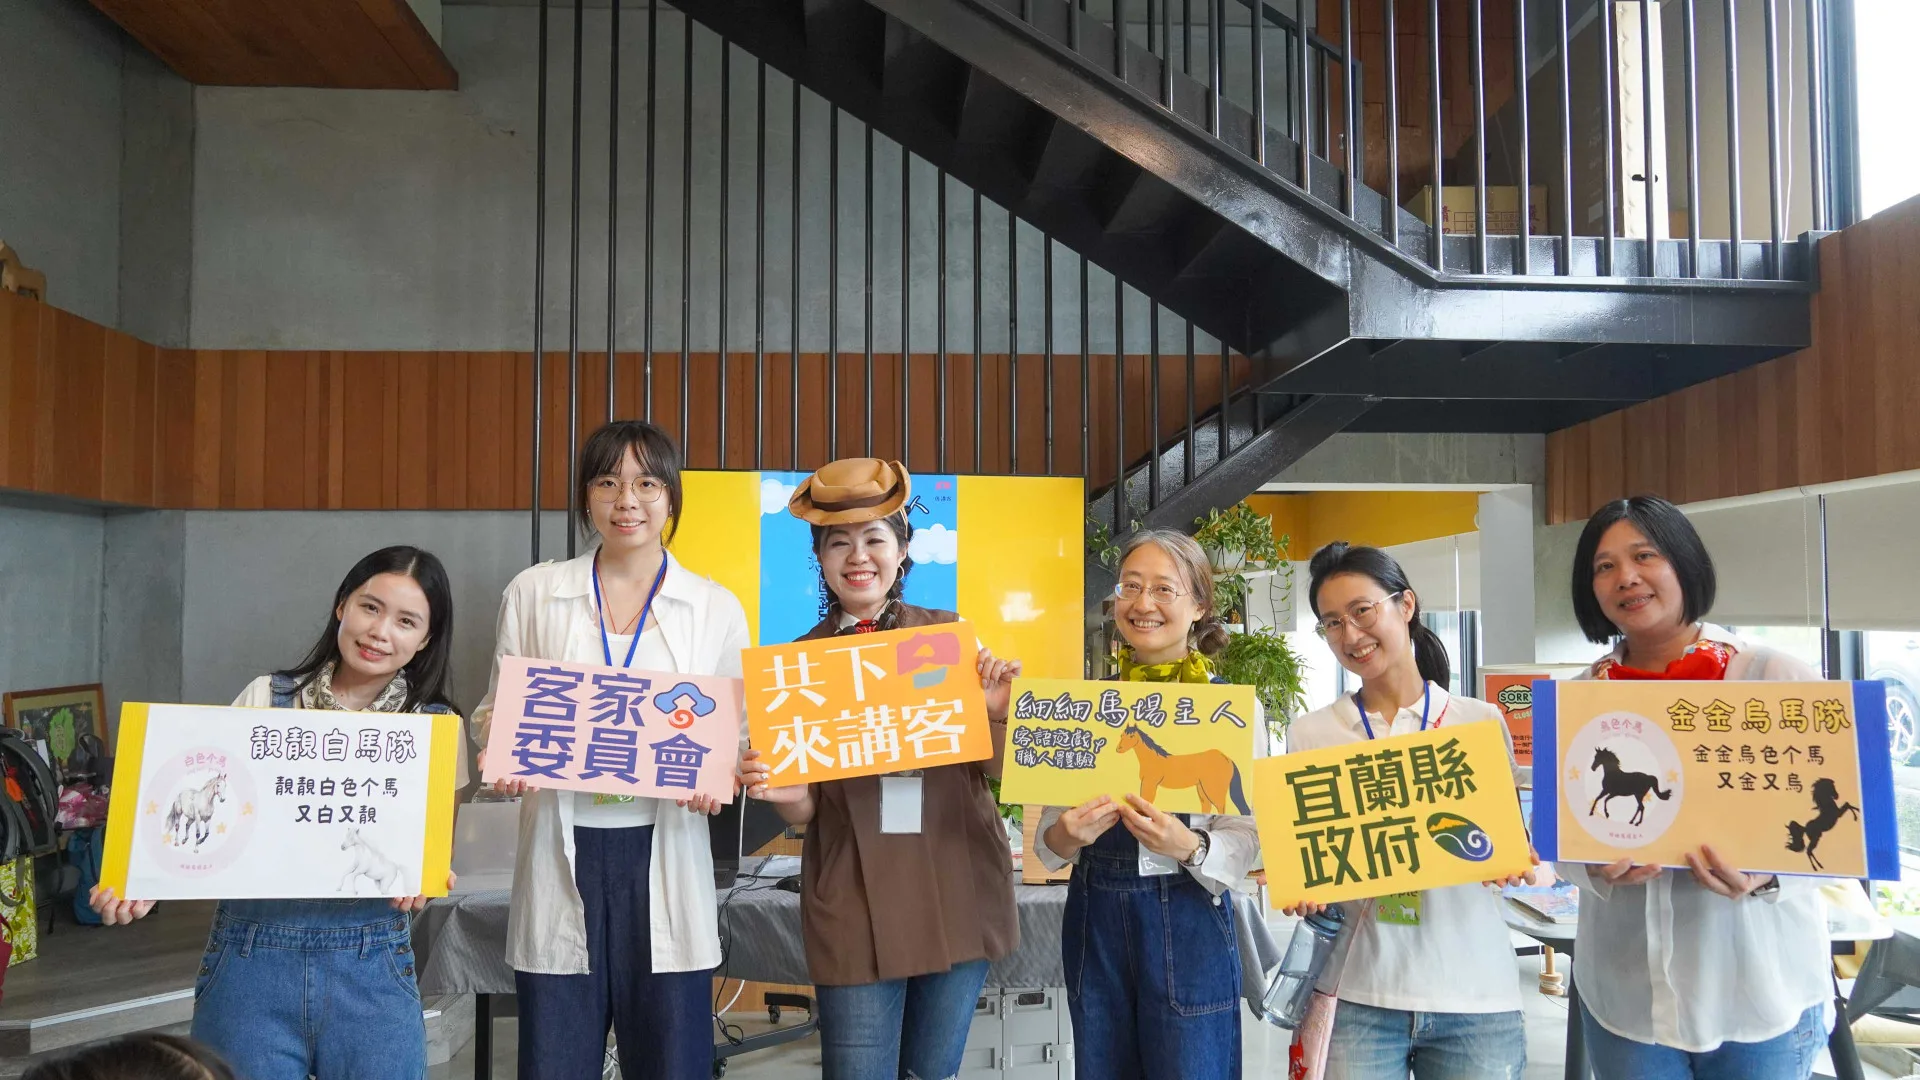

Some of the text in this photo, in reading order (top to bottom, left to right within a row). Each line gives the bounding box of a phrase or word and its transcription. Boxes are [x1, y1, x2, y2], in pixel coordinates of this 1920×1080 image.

[522, 665, 652, 728] 客家
[762, 642, 888, 713] 共下
[1014, 689, 1247, 728] 細細馬場主人
[1667, 698, 1851, 734] 金金烏馬隊
[250, 725, 417, 763] 靚靚白馬隊
[766, 698, 967, 775] 來講客
[1692, 744, 1824, 766] 金金烏色个馬
[510, 722, 713, 790] 委員會
[1015, 746, 1096, 769] 職人體驗
[275, 776, 398, 797] 靚靚白色个馬
[1284, 737, 1478, 827] 宜蘭縣
[1717, 771, 1803, 793] 又金又烏
[295, 804, 377, 824] 又白又靚
[1292, 815, 1421, 889] 政府
